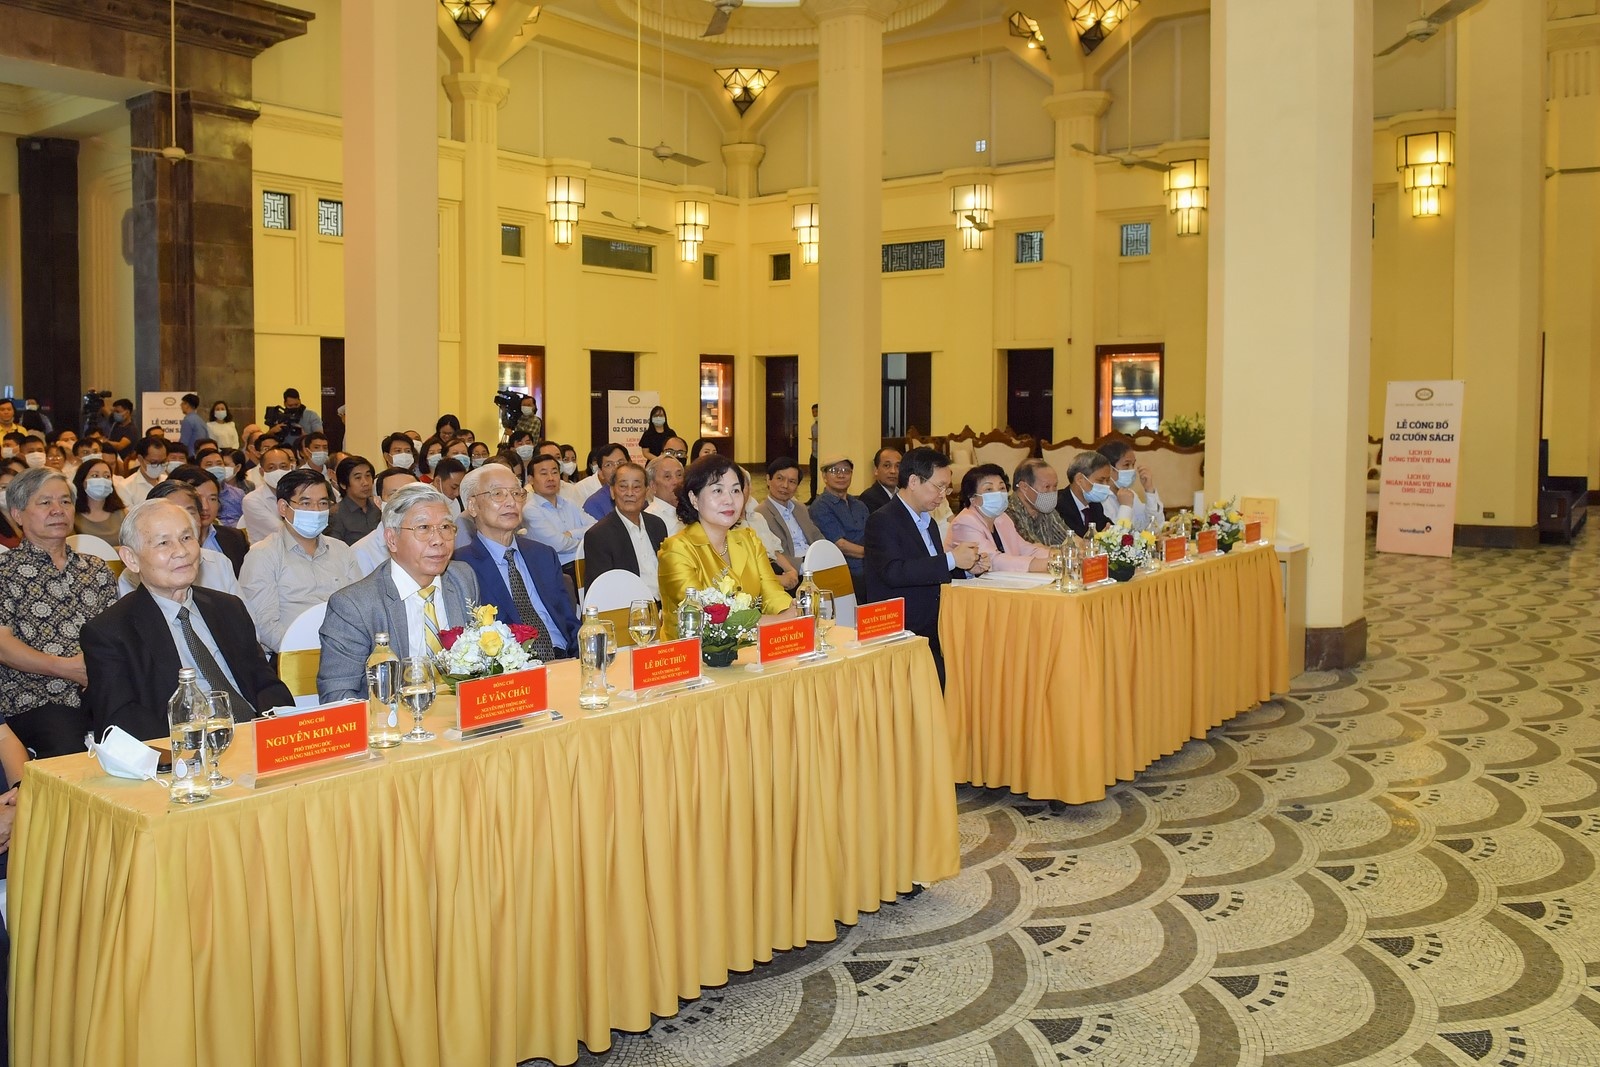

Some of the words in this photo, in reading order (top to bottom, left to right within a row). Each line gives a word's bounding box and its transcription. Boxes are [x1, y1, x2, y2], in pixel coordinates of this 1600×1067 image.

[1396, 419, 1407, 429] LỄ
[1409, 421, 1434, 429] CÔNG
[1436, 420, 1449, 429] BỐ
[1402, 432, 1427, 441] CUỐN
[1429, 433, 1454, 442] SÁCH
[645, 660, 653, 670] LÊ
[655, 657, 668, 667] ĐỨC
[476, 693, 487, 705] LÊ
[489, 691, 507, 702] VĂN
[508, 686, 531, 698] CHÂU
[299, 718, 314, 726] ĐỒNG
[266, 730, 311, 748] NGUYỄN
[313, 726, 333, 739] KIM
[335, 722, 357, 733] ANH
